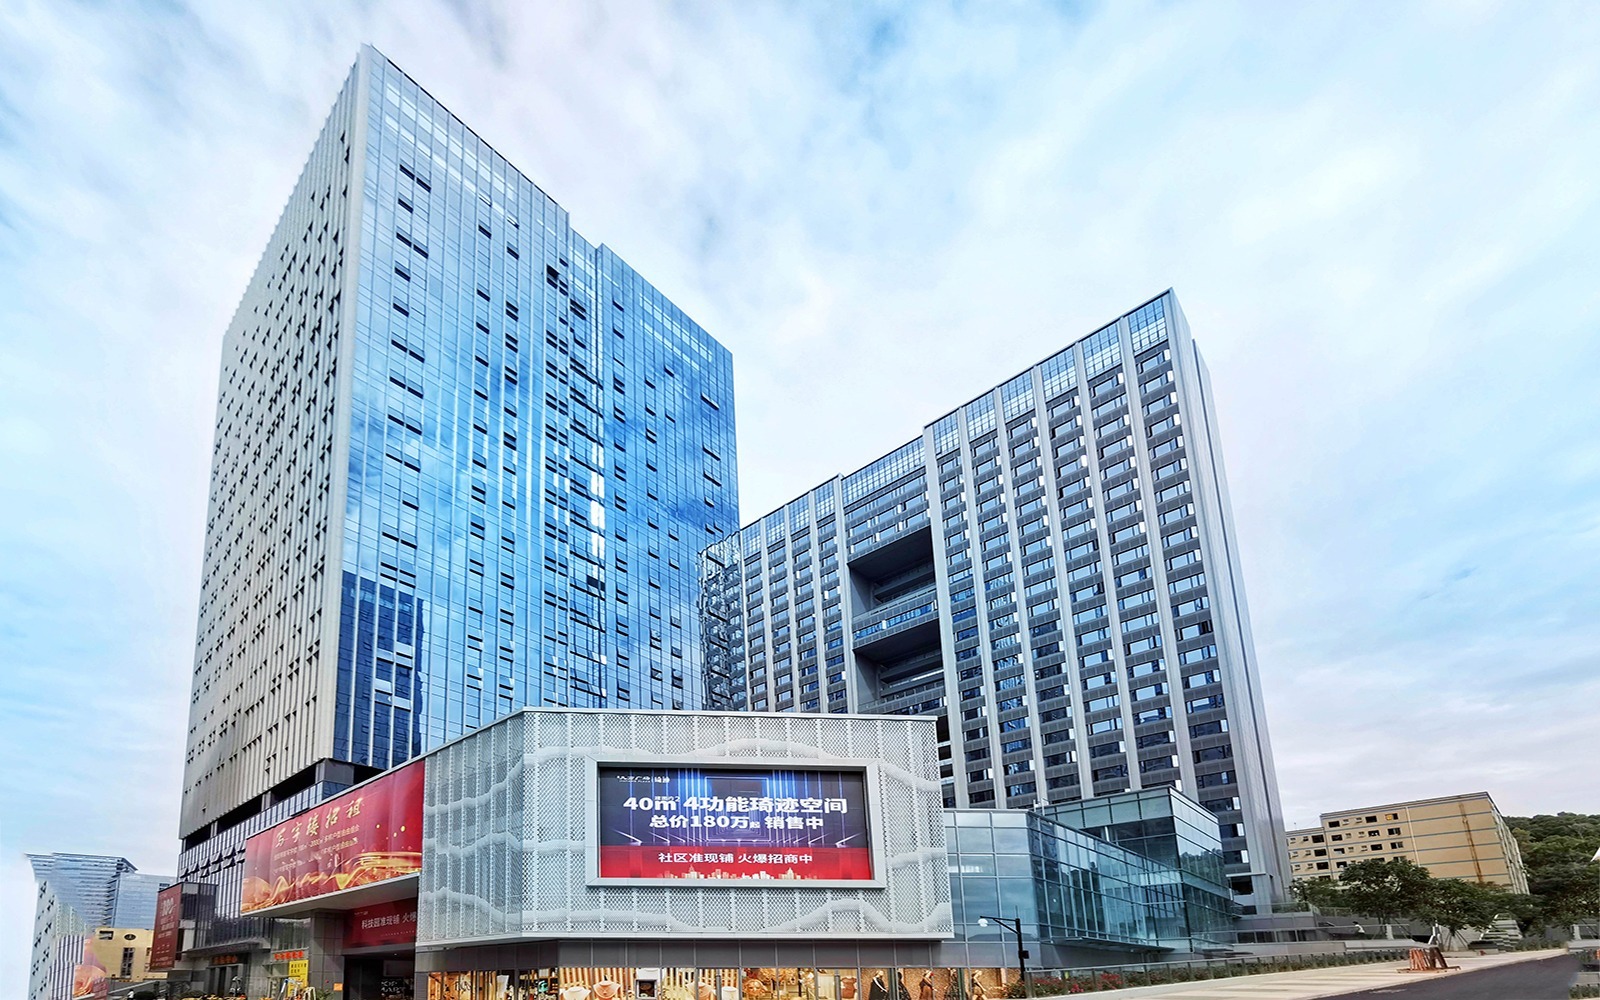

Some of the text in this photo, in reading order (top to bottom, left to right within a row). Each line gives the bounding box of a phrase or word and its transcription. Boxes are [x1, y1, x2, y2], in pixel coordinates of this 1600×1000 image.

[683, 796, 848, 813] 4功能琦迹空间
[764, 816, 823, 829] 销售中
[658, 853, 812, 864] 社区准现铺 火爆招商中
